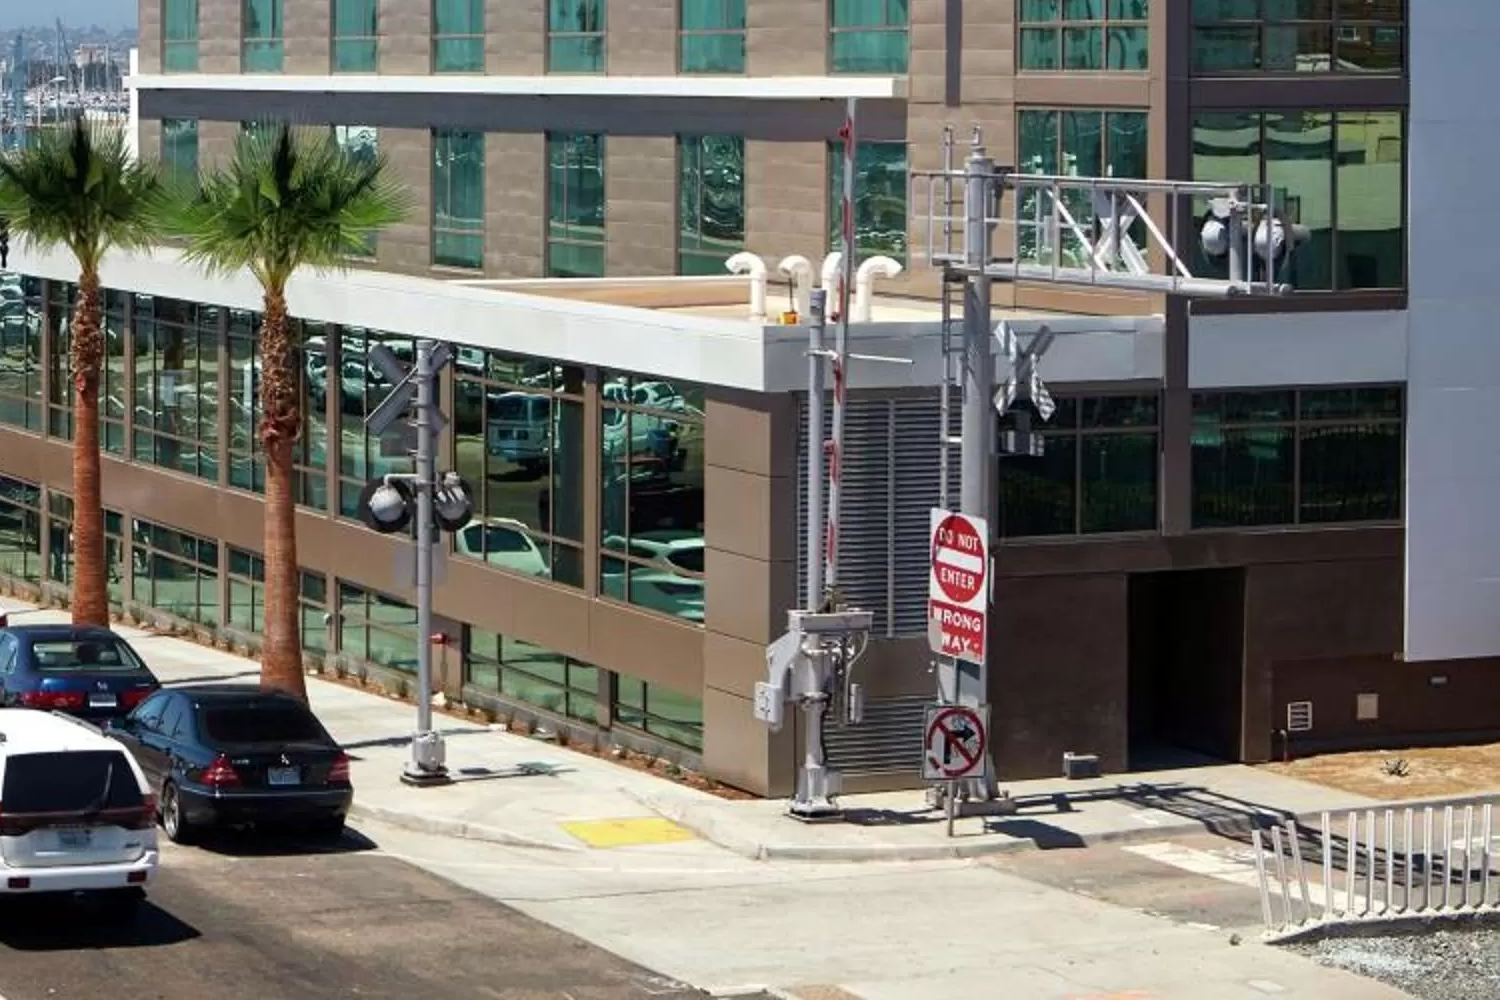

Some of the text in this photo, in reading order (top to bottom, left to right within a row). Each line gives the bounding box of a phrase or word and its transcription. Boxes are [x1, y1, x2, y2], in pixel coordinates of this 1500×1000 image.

[938, 527, 979, 554] DO NOT
[940, 567, 975, 591] ENTER
[933, 606, 981, 632] WRONG
[941, 631, 972, 653] WAY
